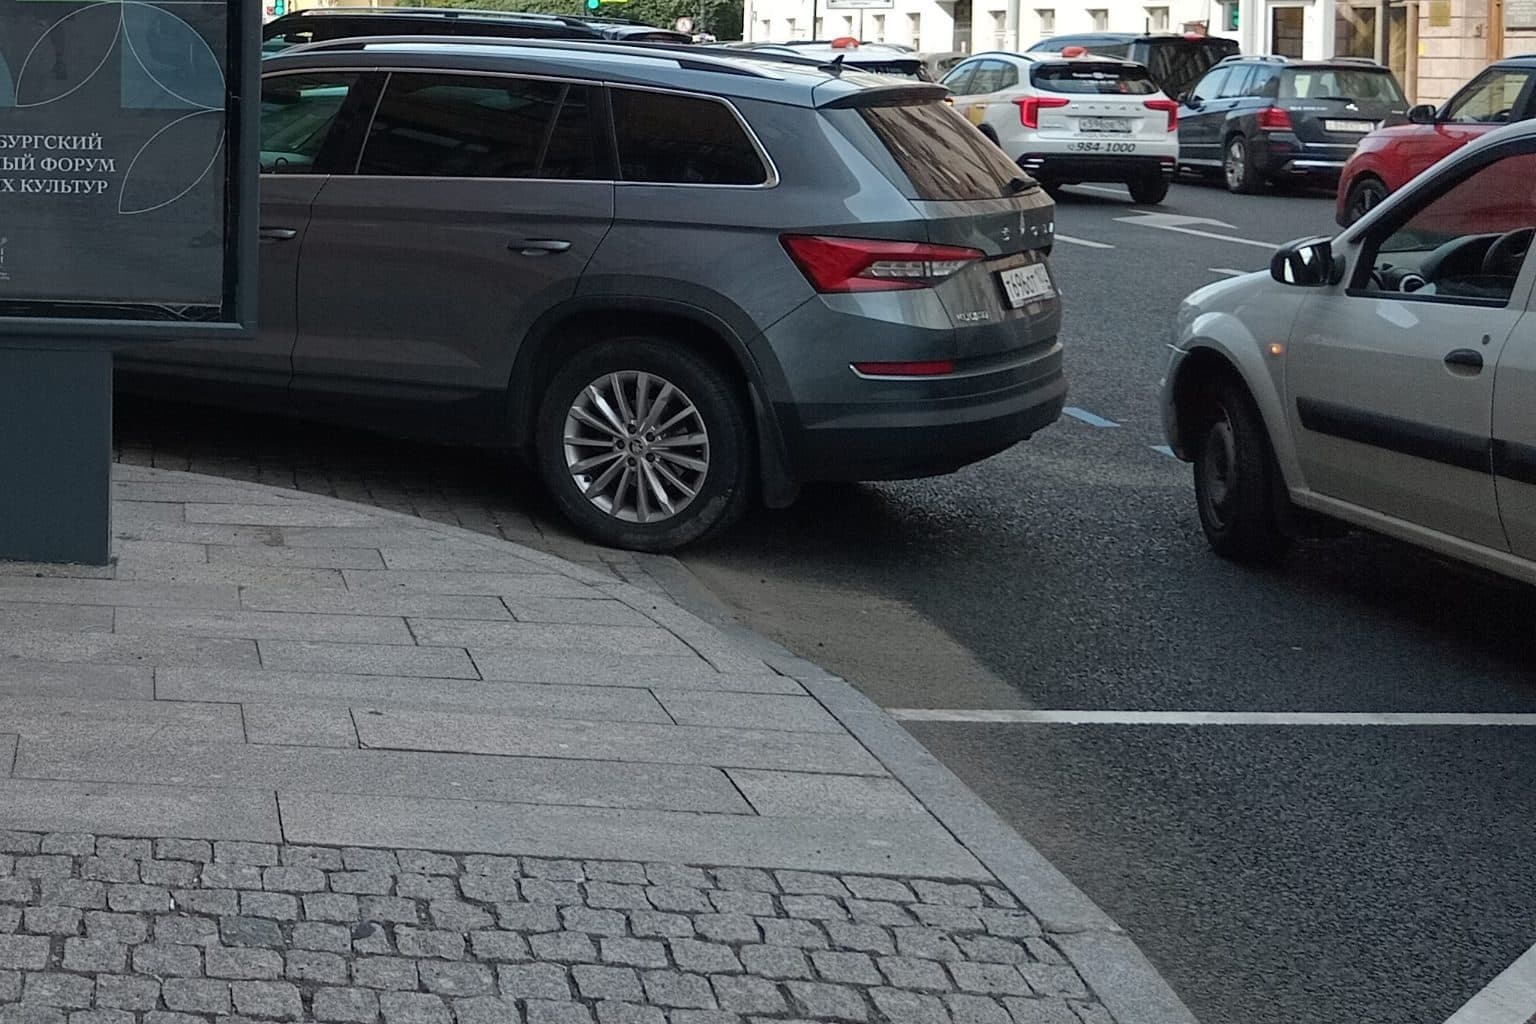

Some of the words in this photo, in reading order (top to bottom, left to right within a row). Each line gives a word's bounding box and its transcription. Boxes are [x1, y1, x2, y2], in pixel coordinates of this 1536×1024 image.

[1075, 141, 1136, 153] 984-1000
[40, 157, 116, 174] ФОРУМ
[20, 178, 109, 195] КУЛЬТУР
